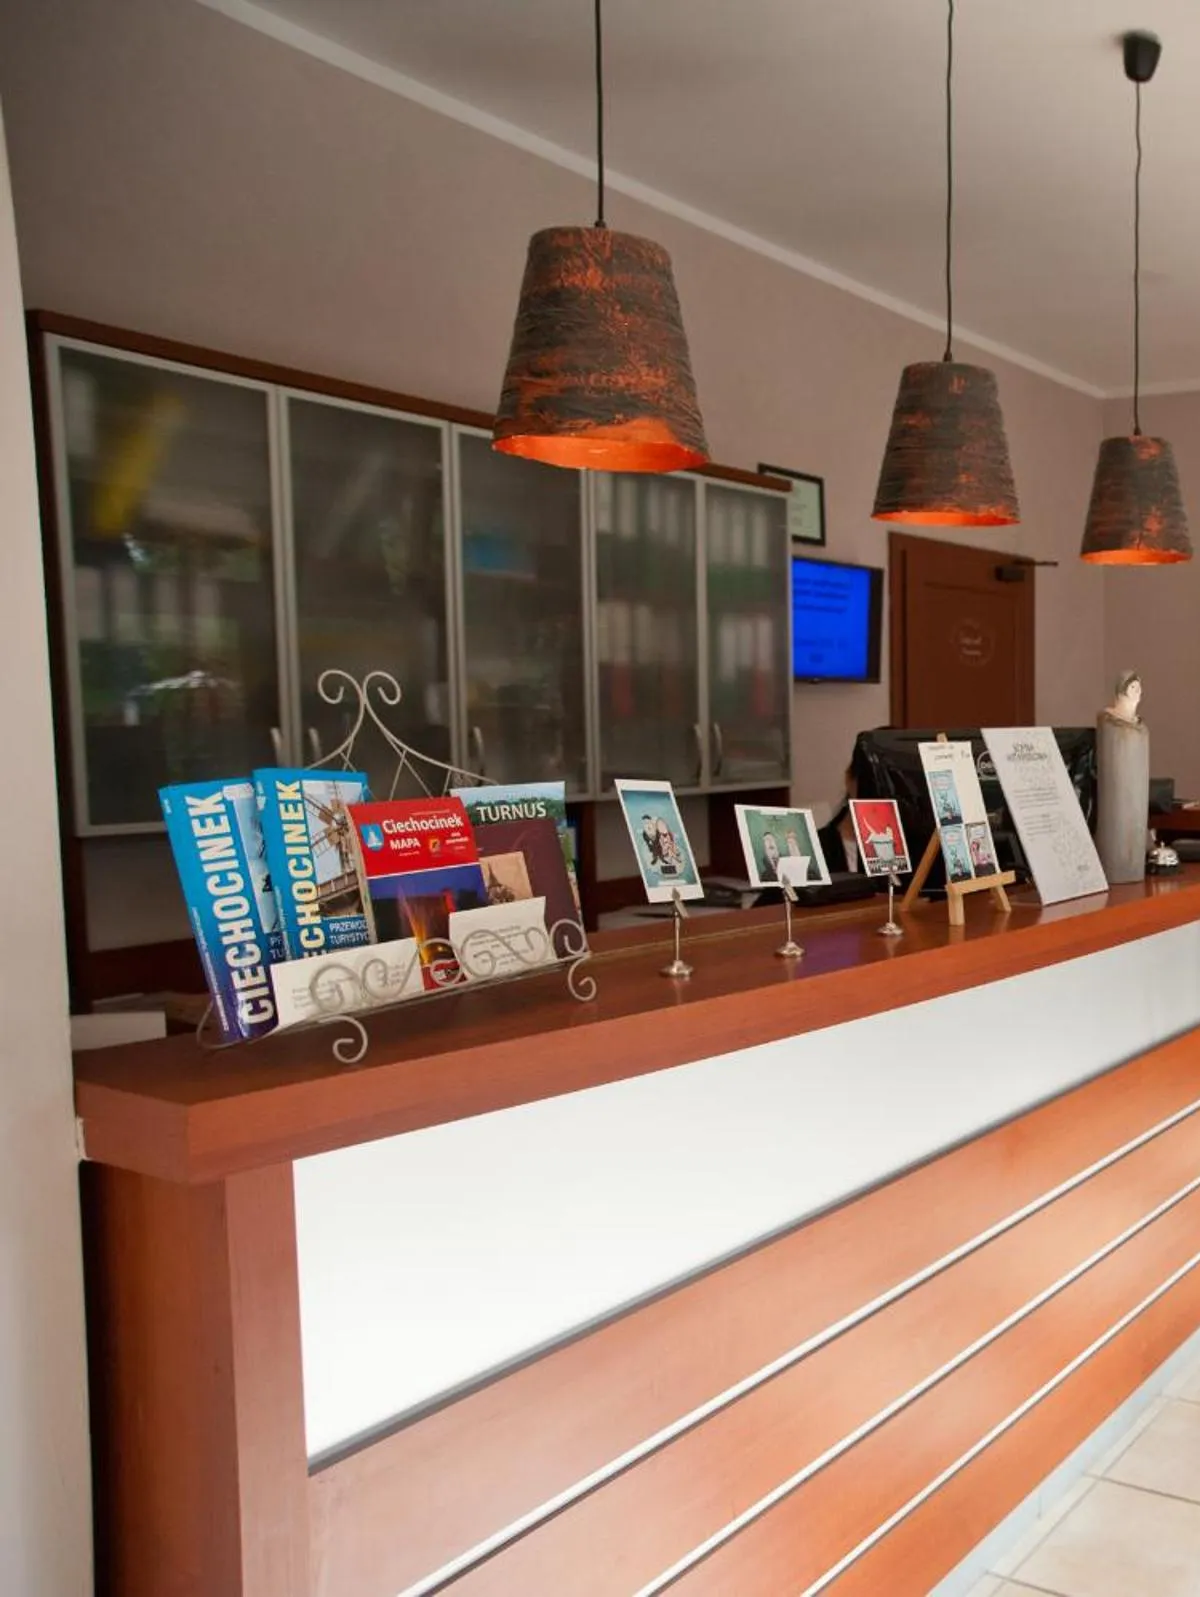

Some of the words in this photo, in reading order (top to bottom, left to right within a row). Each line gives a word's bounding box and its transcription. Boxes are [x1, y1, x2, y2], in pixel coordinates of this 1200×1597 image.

[476, 801, 547, 822] TURNUS
[382, 813, 464, 834] Ciechocinek
[389, 838, 421, 850] MAPA
[185, 791, 275, 1025] CIECHOCINEK
